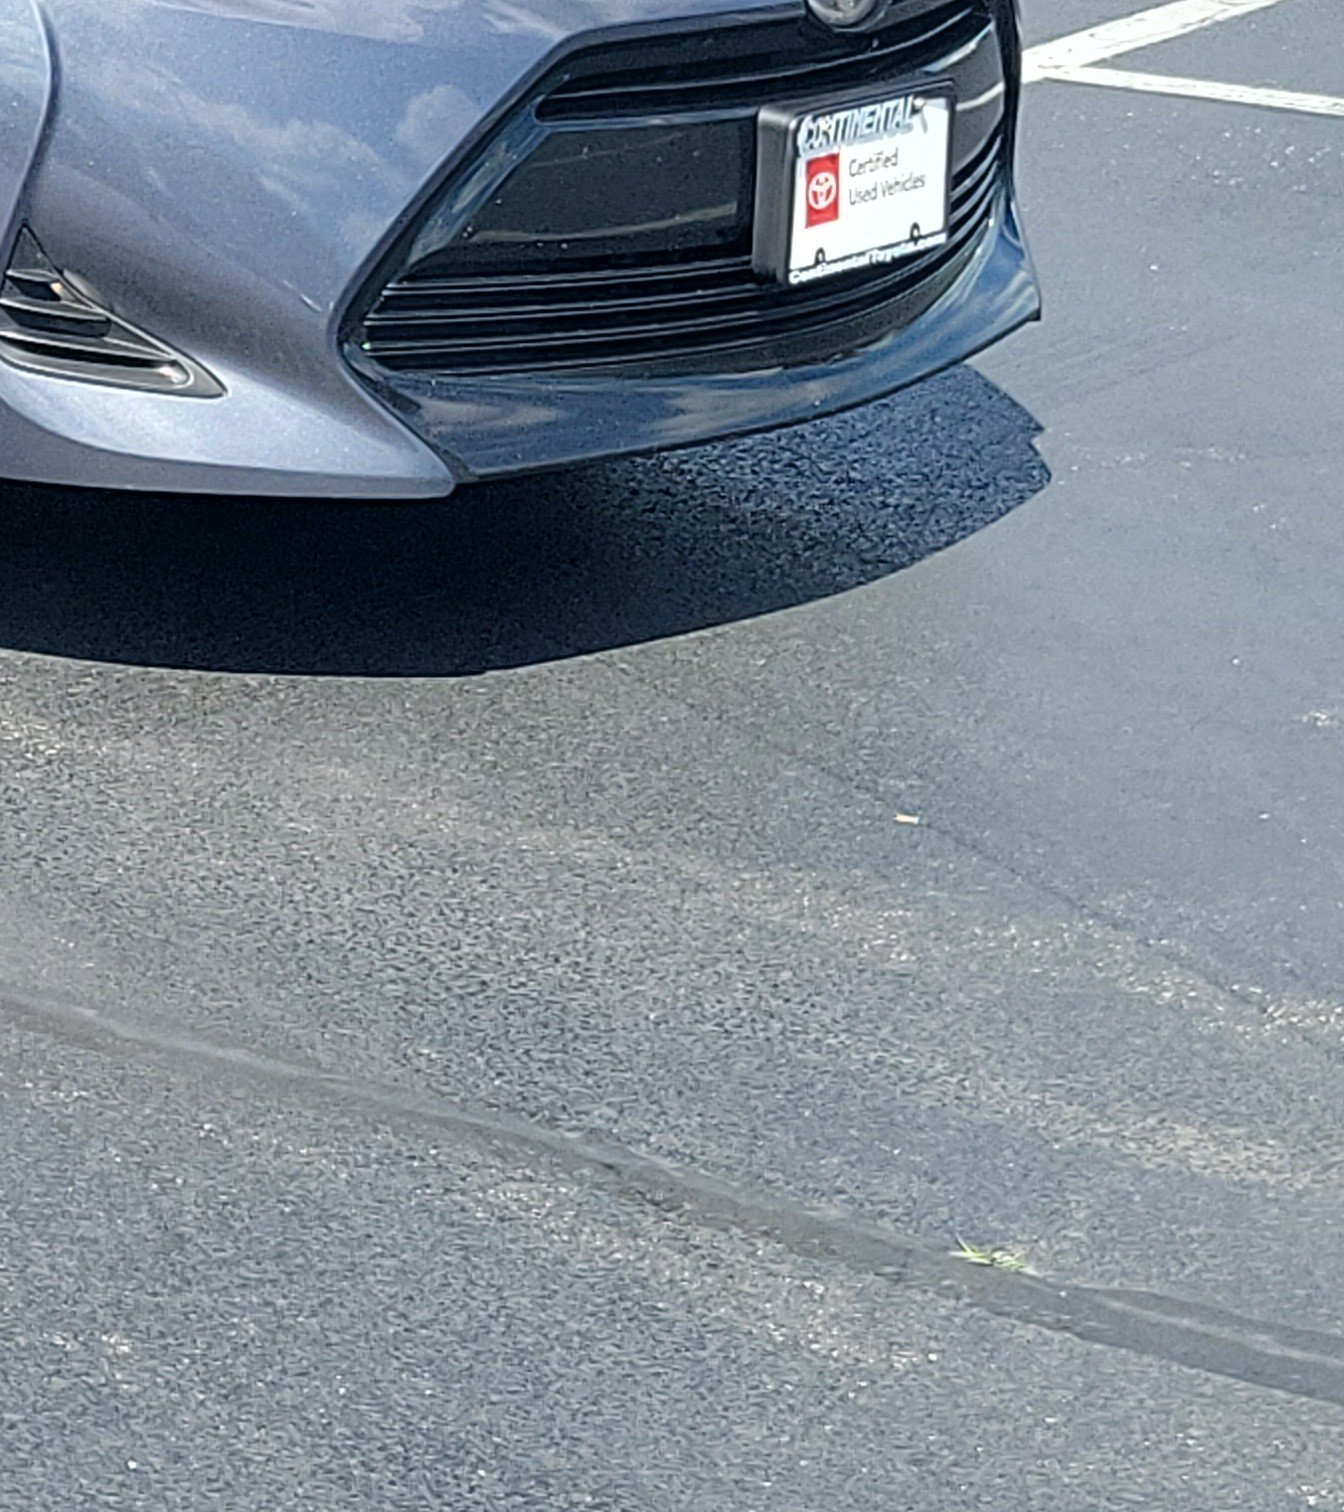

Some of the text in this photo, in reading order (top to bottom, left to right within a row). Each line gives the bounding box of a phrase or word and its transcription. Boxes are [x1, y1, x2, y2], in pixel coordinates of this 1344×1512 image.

[849, 147, 900, 178] Certified
[849, 171, 926, 206] Used Vehicles
